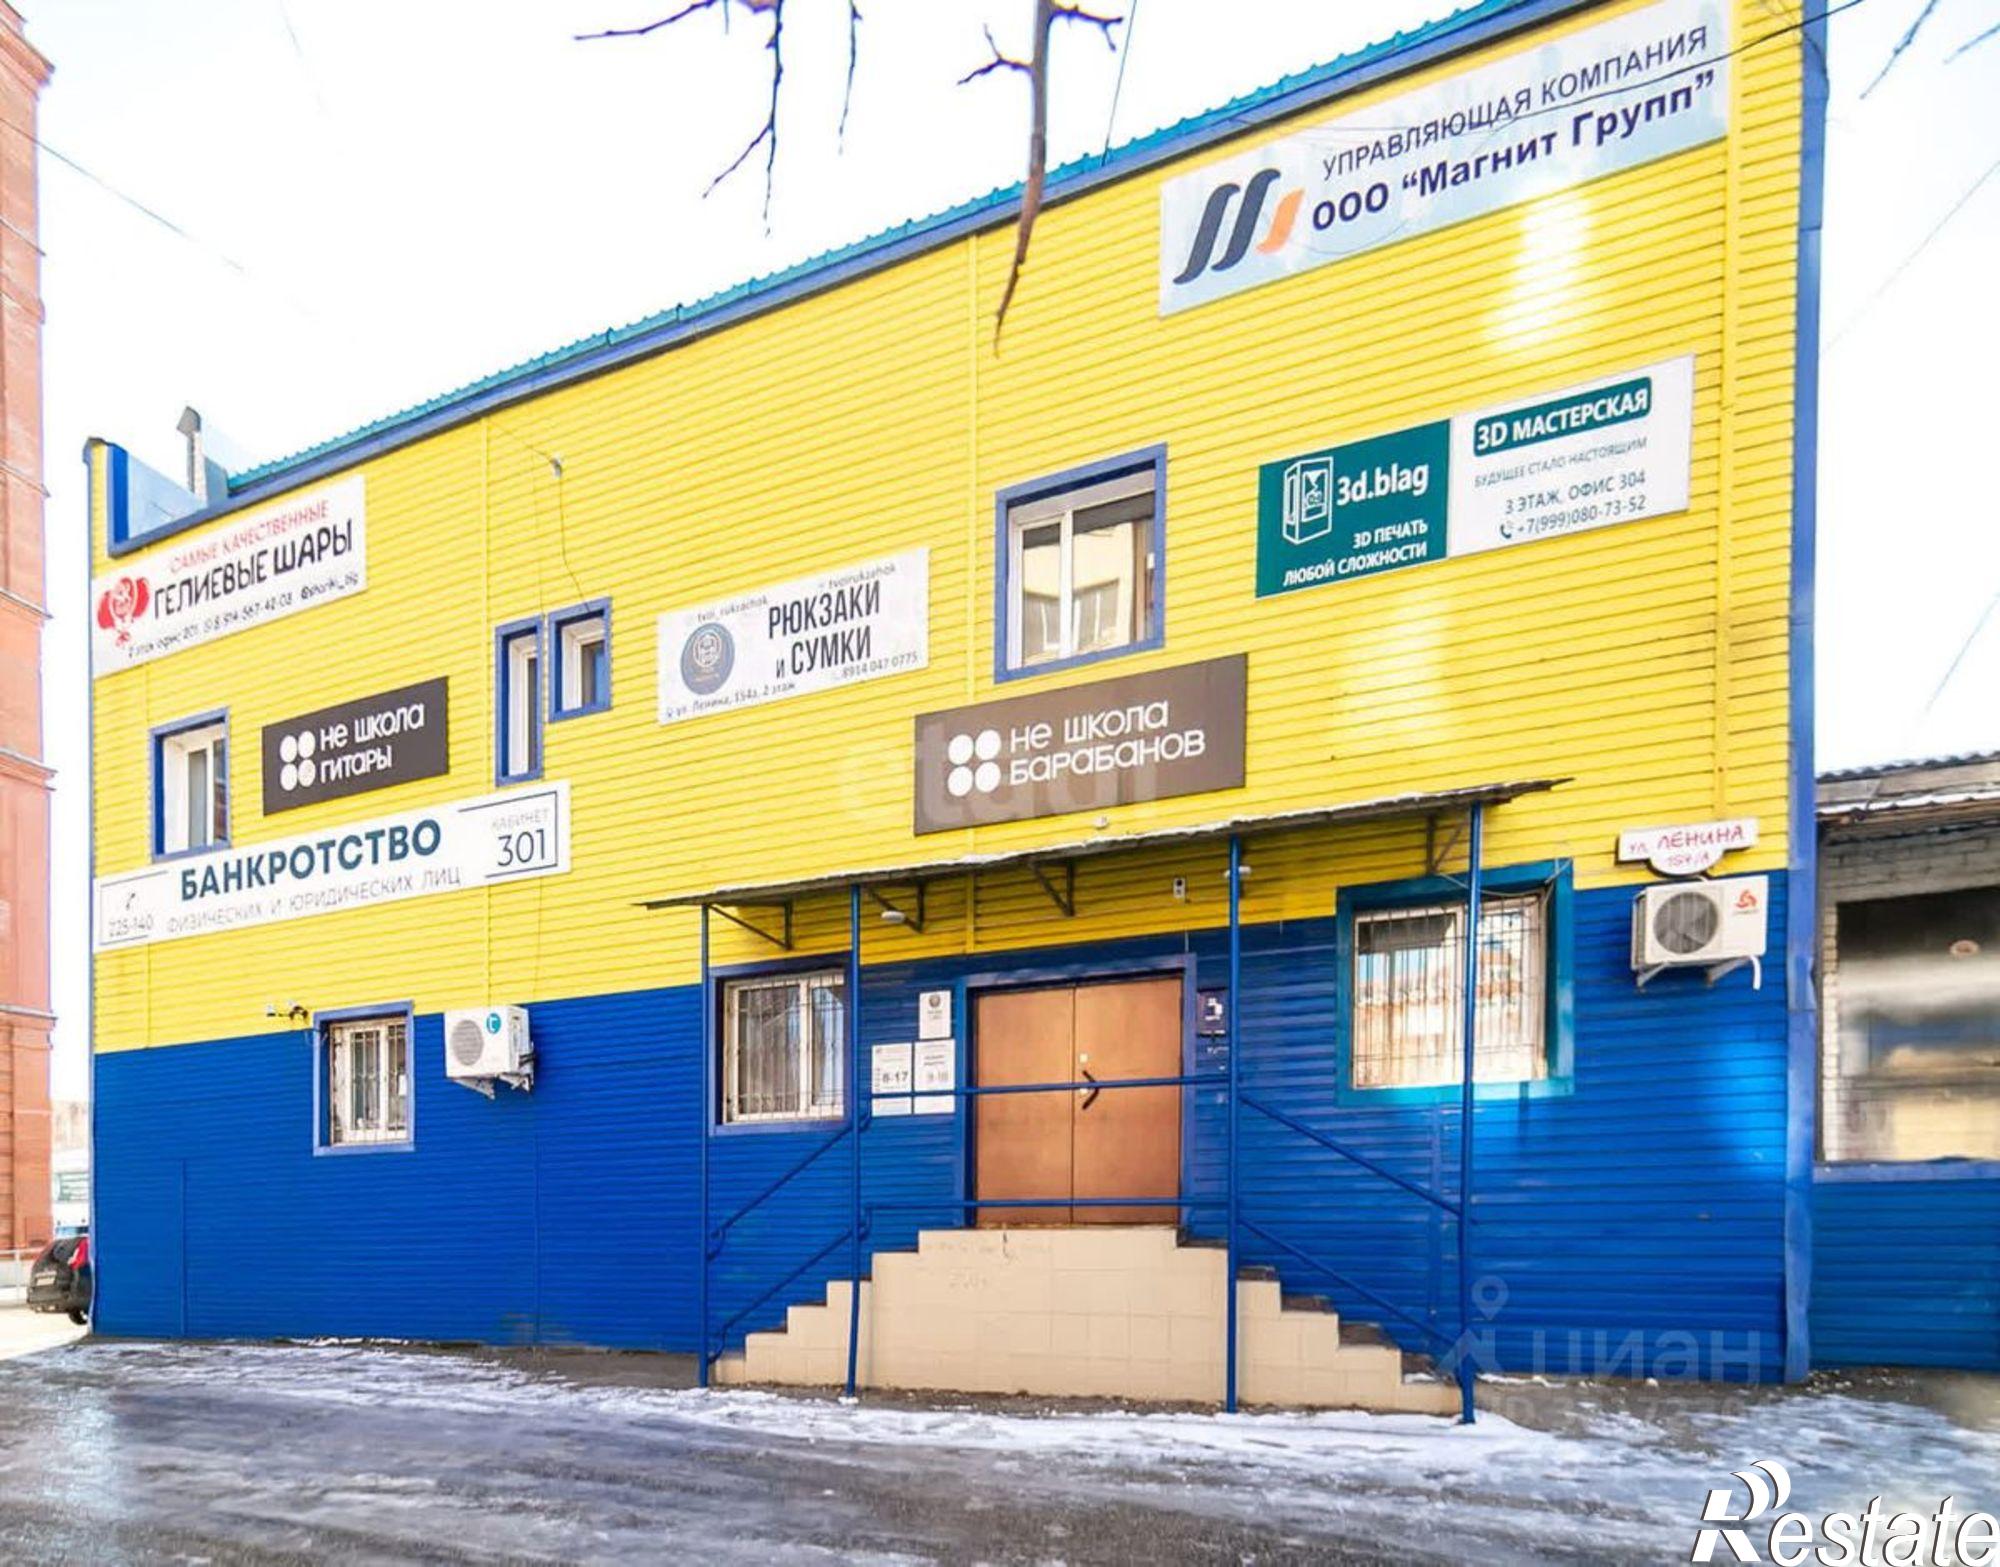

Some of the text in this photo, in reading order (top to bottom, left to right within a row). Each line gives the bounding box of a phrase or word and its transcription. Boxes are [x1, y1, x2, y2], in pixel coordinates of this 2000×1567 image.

[1323, 26, 1708, 181] УПРАВЛЯЮЩАЯ КОМПАНИЯ
[1311, 182, 1389, 231] ООО
[1476, 387, 1649, 451] 3D МАСТЕРСКАЯ
[1528, 457, 1567, 480] СТАЛО
[1570, 436, 1647, 468] НАСТОЯЩИМ
[1337, 462, 1429, 507] 3d.blag
[1505, 499, 1514, 515] 3
[1568, 477, 1616, 502] ОФИС
[1619, 469, 1646, 490] 304
[170, 499, 329, 573] САМЫЕ КАЧЕСТВЕННЫЕ
[1353, 519, 1428, 549] 3D ПЕЧАТЬ
[153, 518, 352, 620] ГЕЛИЕВЫЕ ШАРЫ
[1283, 542, 1428, 587] ЛЮБОЙ СЛОЖНОСТИ
[768, 579, 880, 639] РЮКЗАКИ
[791, 625, 871, 675] СУМКИ
[181, 817, 442, 902] БАНКРОТСТВО
[496, 827, 547, 868] 301
[1656, 825, 1745, 850] ЛЕНИНА
[165, 900, 264, 935] ФИЗИЧЕСКИХ
[288, 875, 413, 912] ЮРИДИЧЕСКИХ
[420, 867, 462, 893] ЛИЦ
